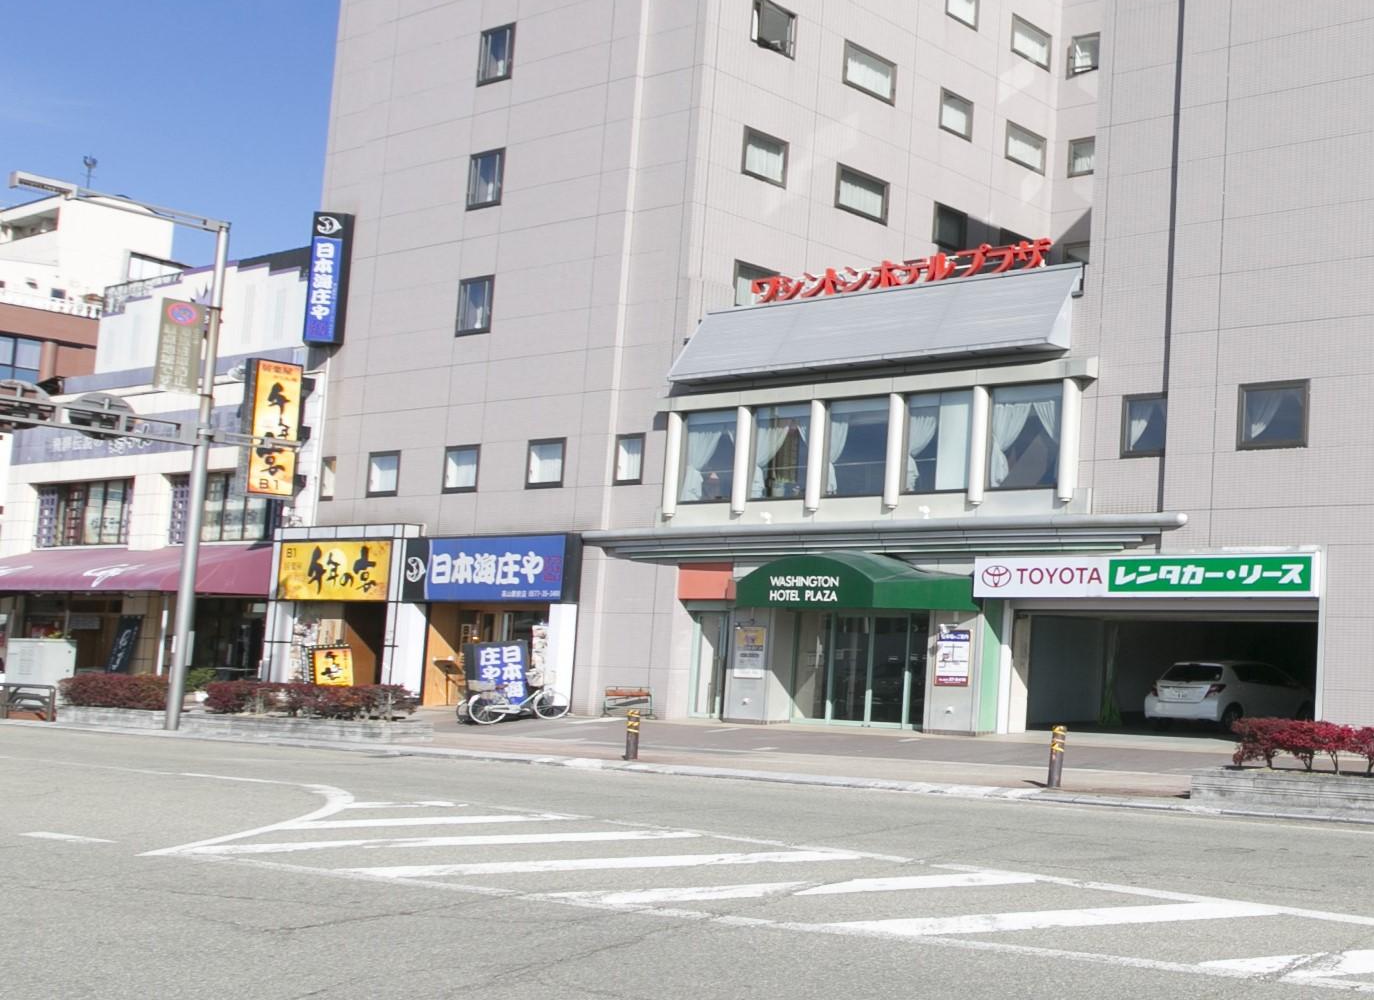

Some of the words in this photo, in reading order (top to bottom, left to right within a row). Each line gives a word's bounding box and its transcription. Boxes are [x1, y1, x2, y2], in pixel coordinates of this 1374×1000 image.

[309, 242, 335, 320] 日本海庄や
[751, 238, 1054, 304] ワシントンホテルプラザ
[431, 551, 544, 584] 日本海庄や
[1016, 567, 1103, 585] TOYOTA
[1114, 564, 1304, 586] レンタカー・リース
[769, 576, 839, 588] WASHINGTON
[769, 590, 800, 602] HOTEL
[804, 590, 838, 602] PLAZA
